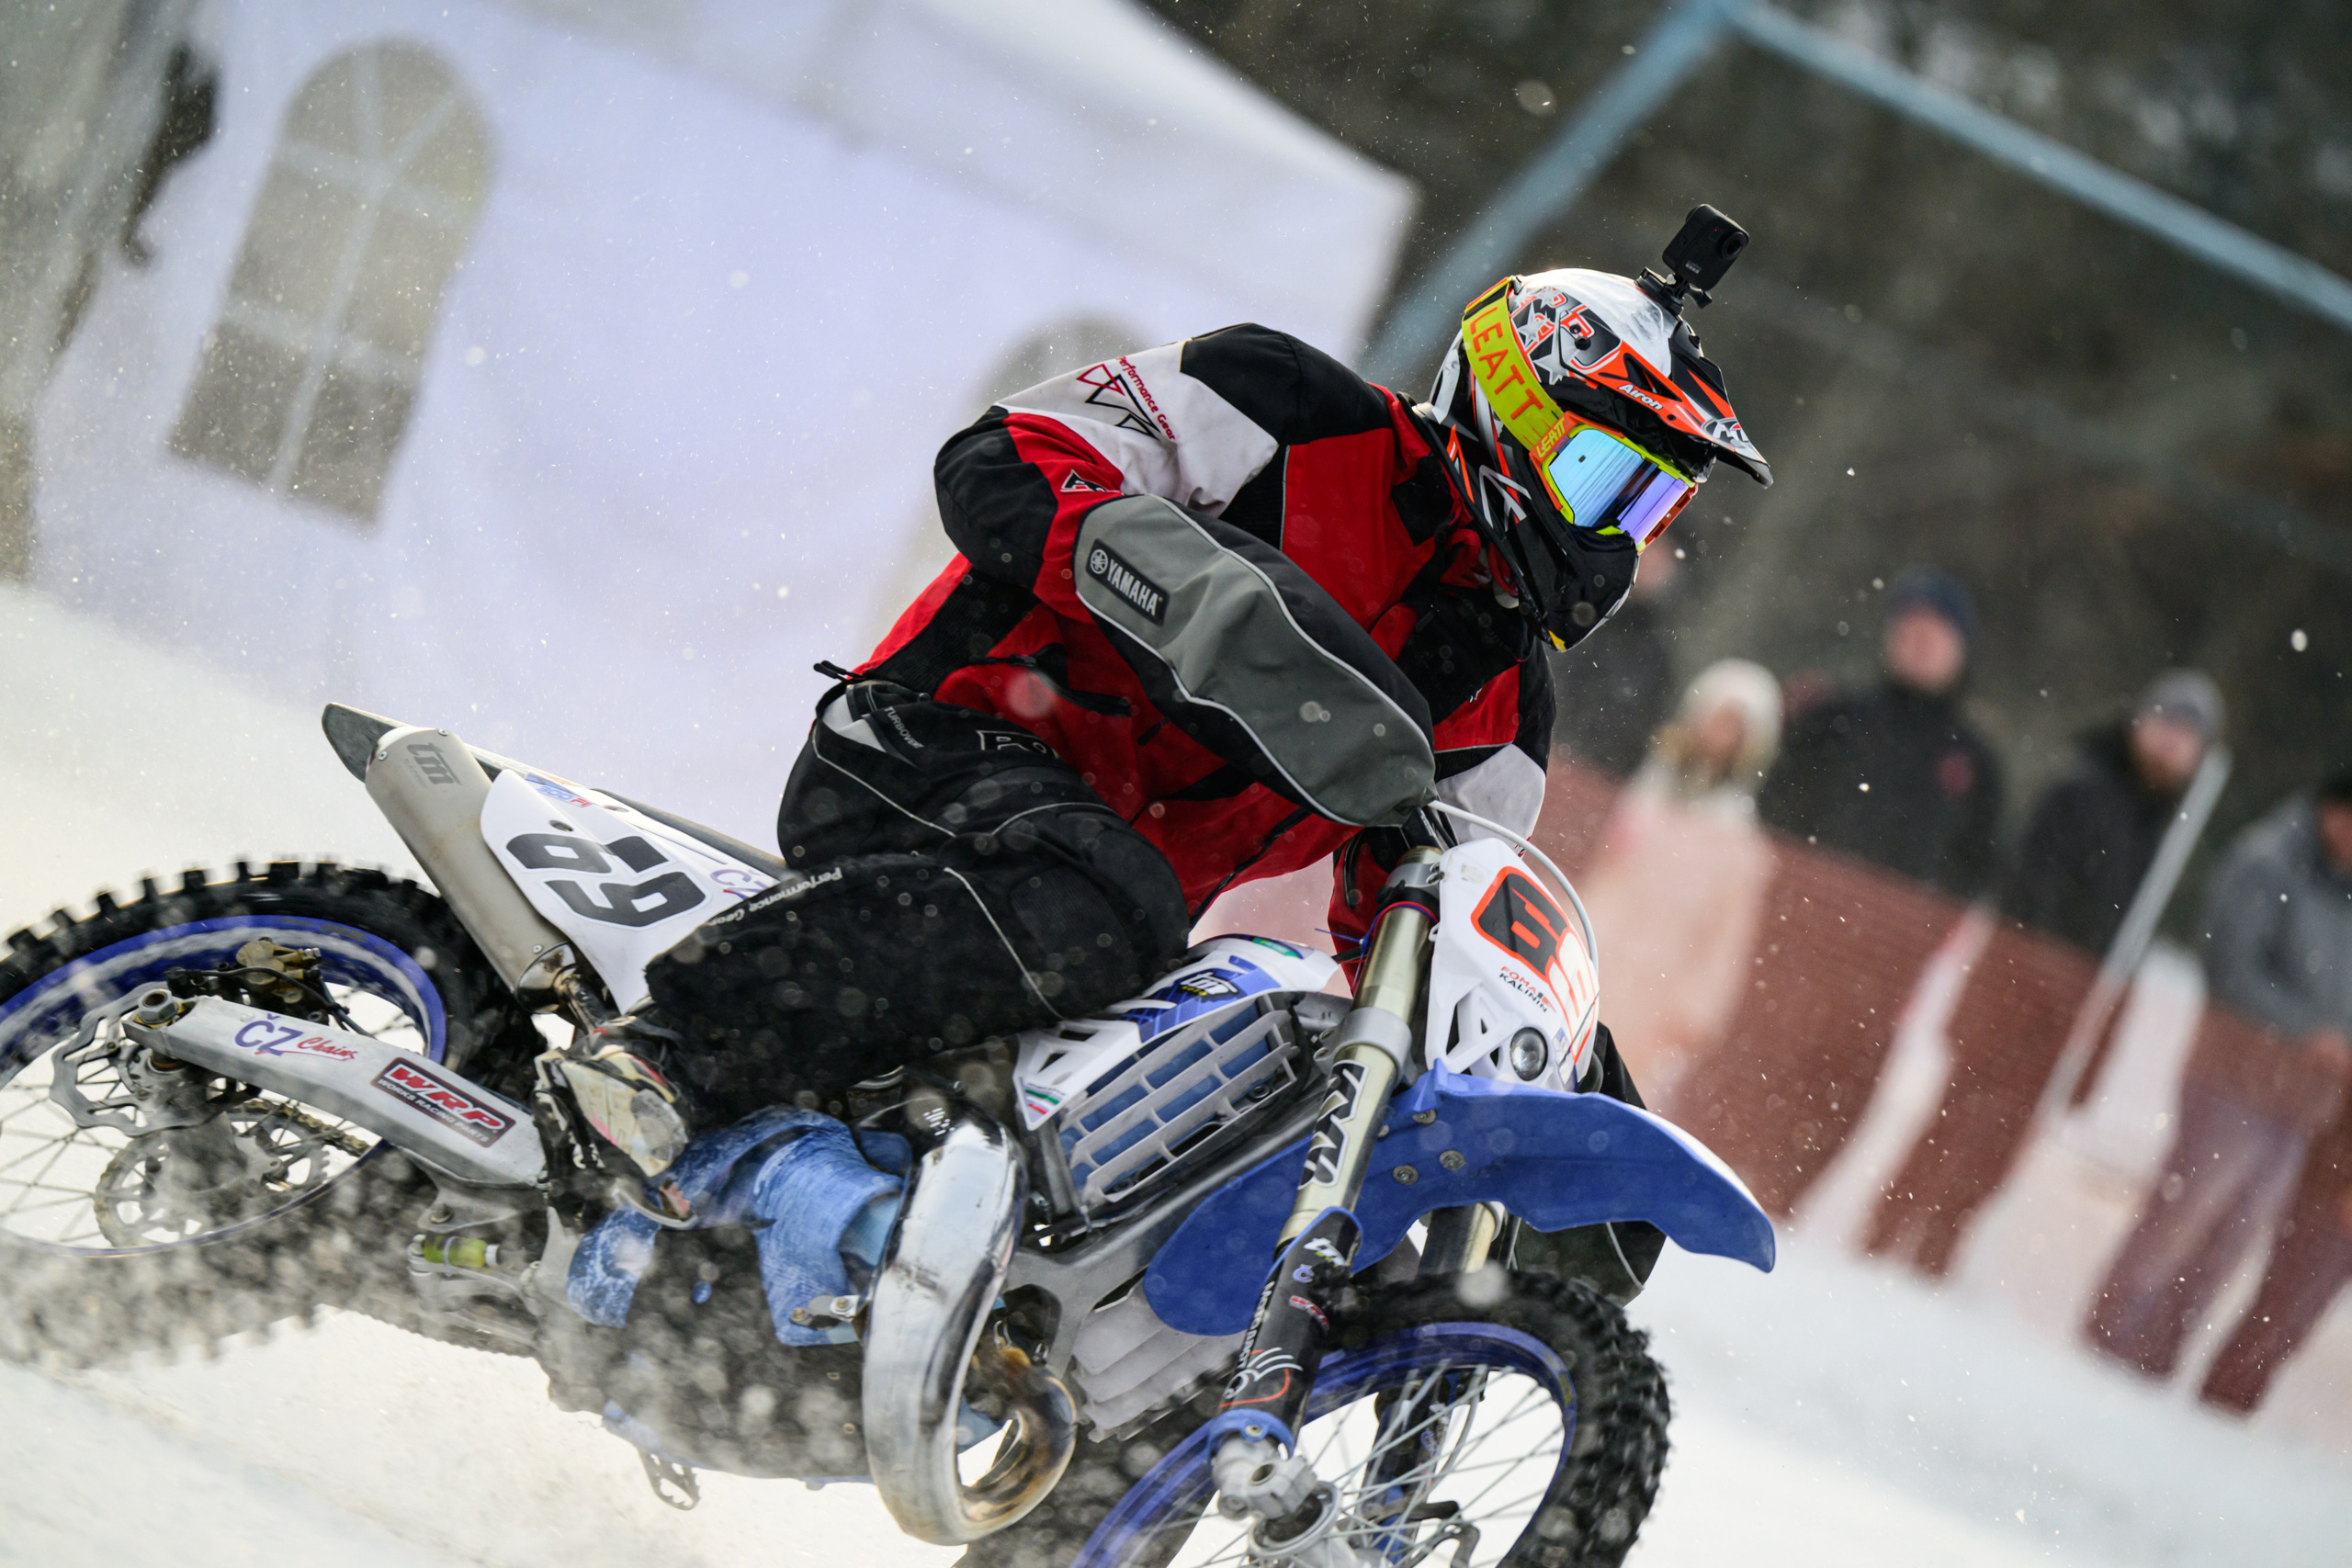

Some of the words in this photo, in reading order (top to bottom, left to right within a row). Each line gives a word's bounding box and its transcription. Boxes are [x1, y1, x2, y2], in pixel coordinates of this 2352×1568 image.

[1470, 306, 1544, 420] LEATT
[1157, 413, 1175, 440] Gear
[1535, 417, 1566, 457] LEATT
[1106, 558, 1161, 616] YAMAHA
[504, 832, 707, 928] 69
[749, 867, 843, 912] Performance
[1499, 973, 1547, 1012] KALININ
[1500, 965, 1537, 995] FOMA
[234, 1013, 304, 1056] ČZ
[378, 1078, 417, 1101] WORKS
[415, 1098, 457, 1124] RACING
[453, 1120, 491, 1143] PARTS
[383, 1064, 506, 1130] WRP
